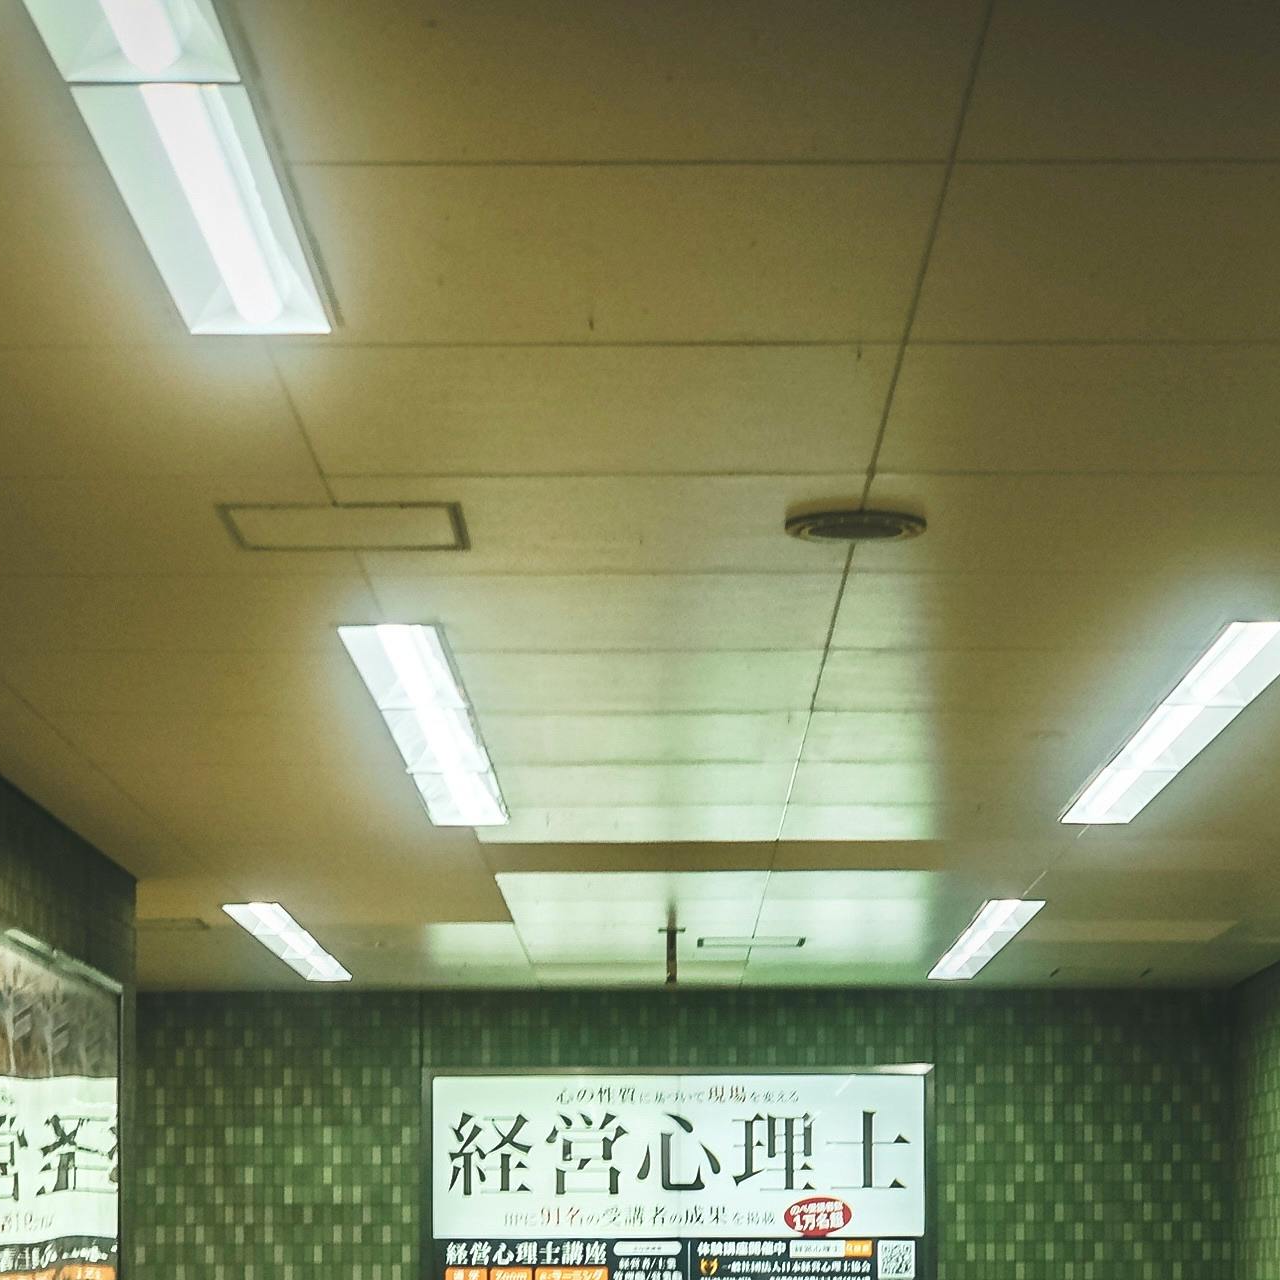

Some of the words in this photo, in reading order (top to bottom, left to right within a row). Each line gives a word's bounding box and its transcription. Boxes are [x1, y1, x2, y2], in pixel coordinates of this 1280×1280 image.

[448, 1111, 912, 1196] 経営心理士
[445, 1241, 608, 1266] 経営心理士講座
